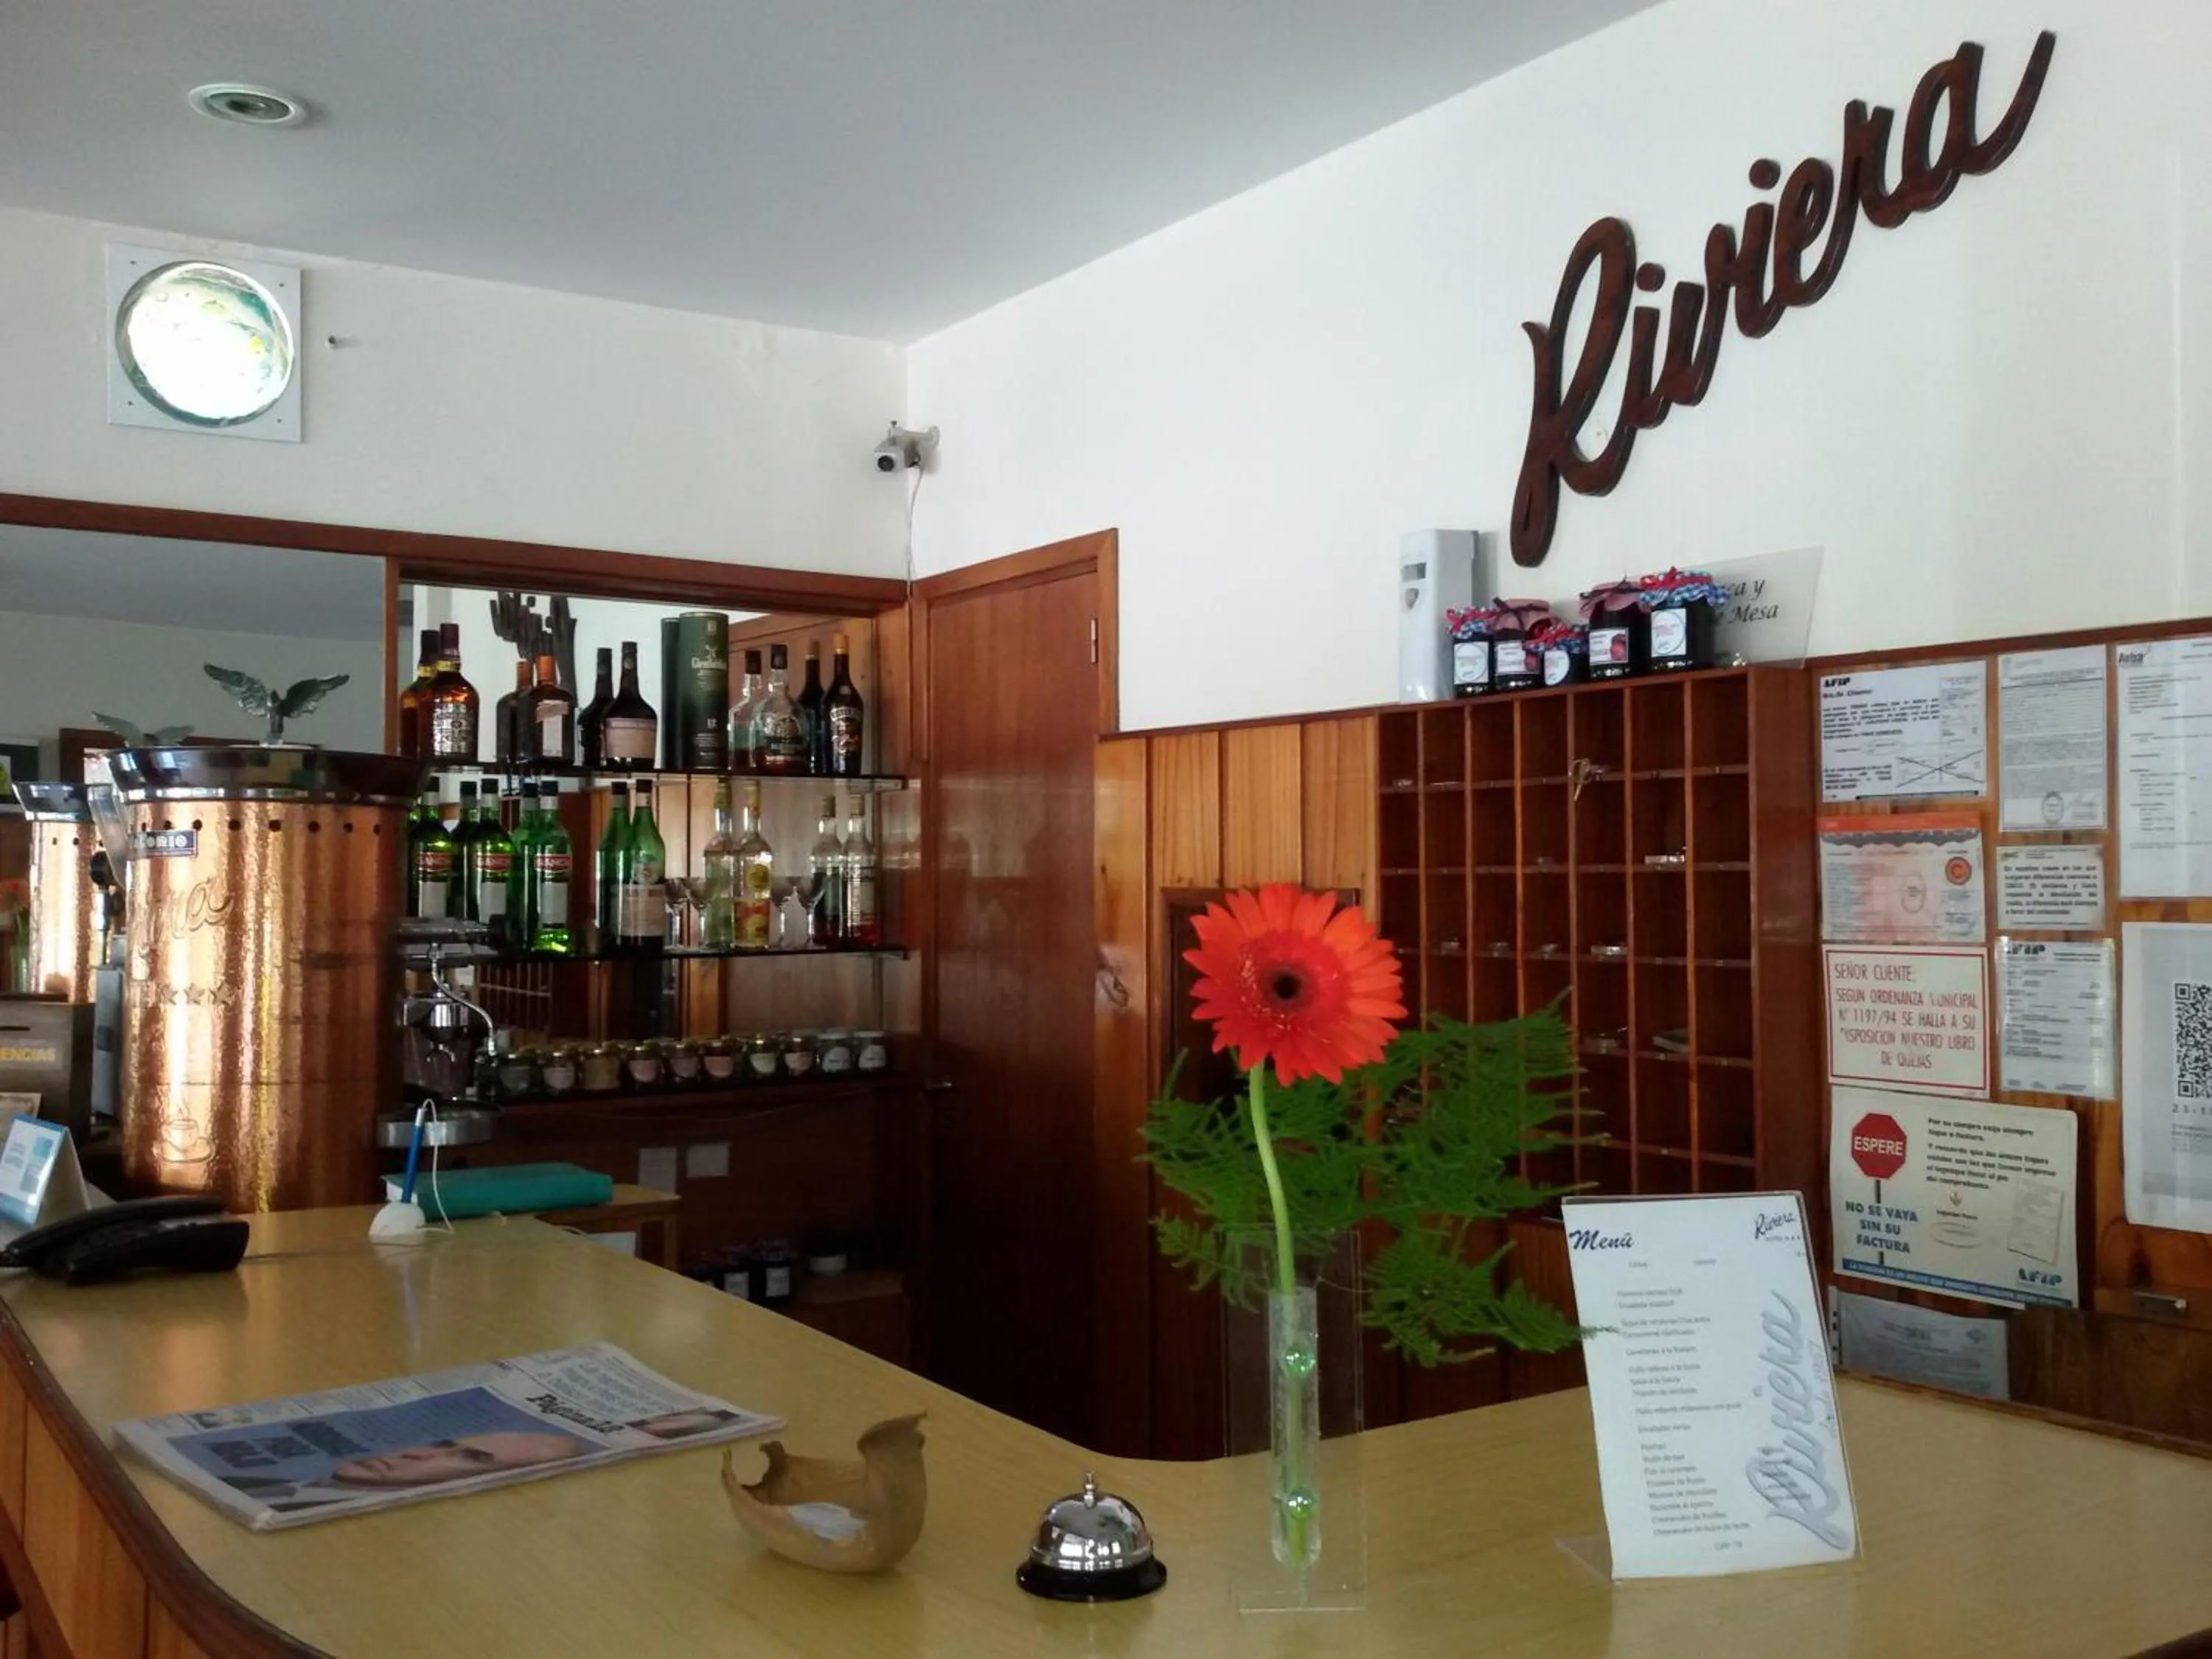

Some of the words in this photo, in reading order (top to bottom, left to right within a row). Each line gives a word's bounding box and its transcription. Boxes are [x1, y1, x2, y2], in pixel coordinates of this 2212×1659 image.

[1510, 30, 2056, 566] Riviera
[1728, 603, 1778, 624] Mesa
[1902, 1011, 1913, 1026] SE
[1919, 1012, 1946, 1029] HALLA
[1951, 1014, 1957, 1029] A
[1962, 1014, 1976, 1030] SU
[1947, 1034, 1976, 1051] LIBRO
[1881, 1050, 1892, 1066] DE
[1854, 1135, 1904, 1157] ESPERE
[1845, 1200, 1865, 1214] NO
[1868, 1203, 1882, 1217] SE
[1885, 1206, 1919, 1223] VAYA
[1859, 1219, 1881, 1233] SIN
[1885, 1222, 1902, 1237] SU
[1856, 1233, 1911, 1254] FACTURA
[1745, 1288, 1851, 1551] Riviera
